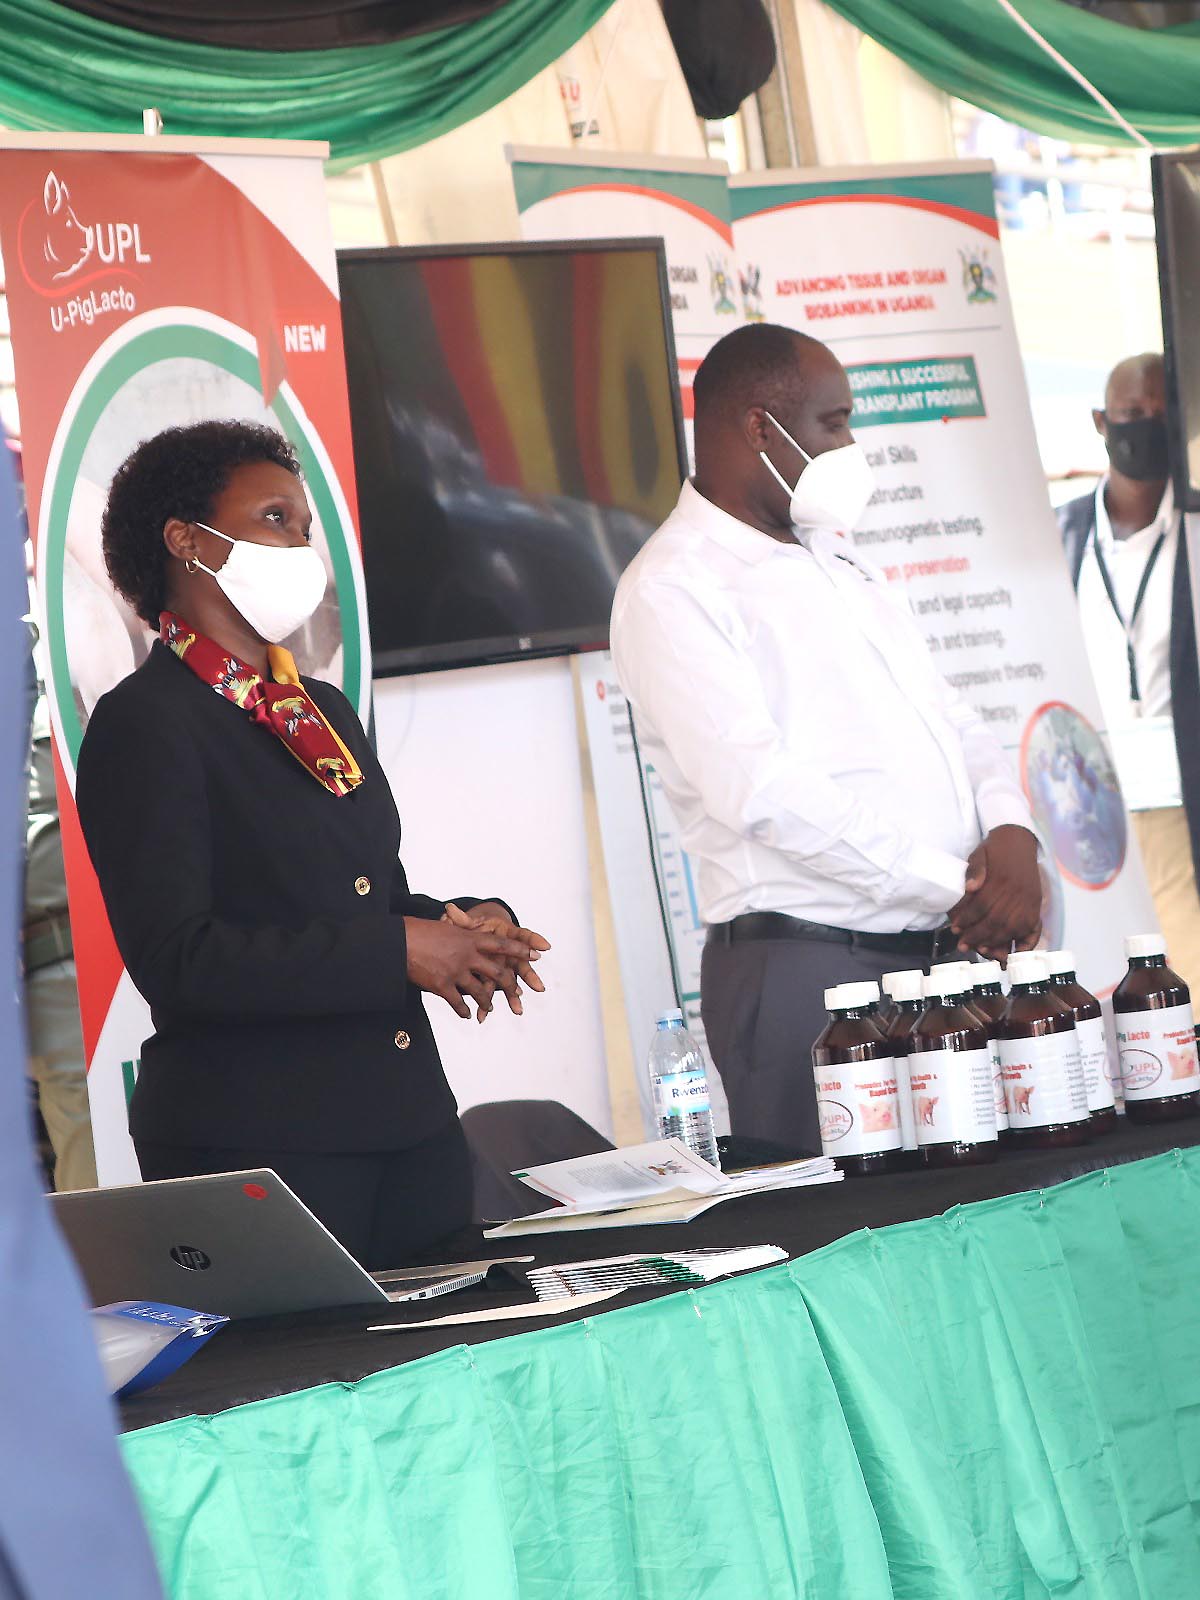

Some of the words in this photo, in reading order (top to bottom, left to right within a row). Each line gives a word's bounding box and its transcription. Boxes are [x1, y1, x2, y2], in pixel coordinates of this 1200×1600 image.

[96, 223, 151, 263] UPL
[776, 275, 846, 296] ADVANCING
[848, 272, 885, 289] TISSUE
[887, 270, 909, 286] AND
[911, 268, 947, 284] ORGAN
[50, 286, 136, 331] U-PigLacto
[805, 299, 875, 320] BIOBANKING
[877, 298, 889, 314] IN
[890, 294, 935, 313] UGANDA
[283, 324, 326, 352] NEW
[891, 368, 902, 385] A
[900, 362, 971, 385] SUCCESSFUL
[924, 386, 980, 409] PROGRAM
[1127, 1031, 1150, 1041] Lacto
[1134, 1063, 1158, 1072] UPL
[821, 1082, 842, 1092] Lacto
[828, 1113, 850, 1124] UPL
